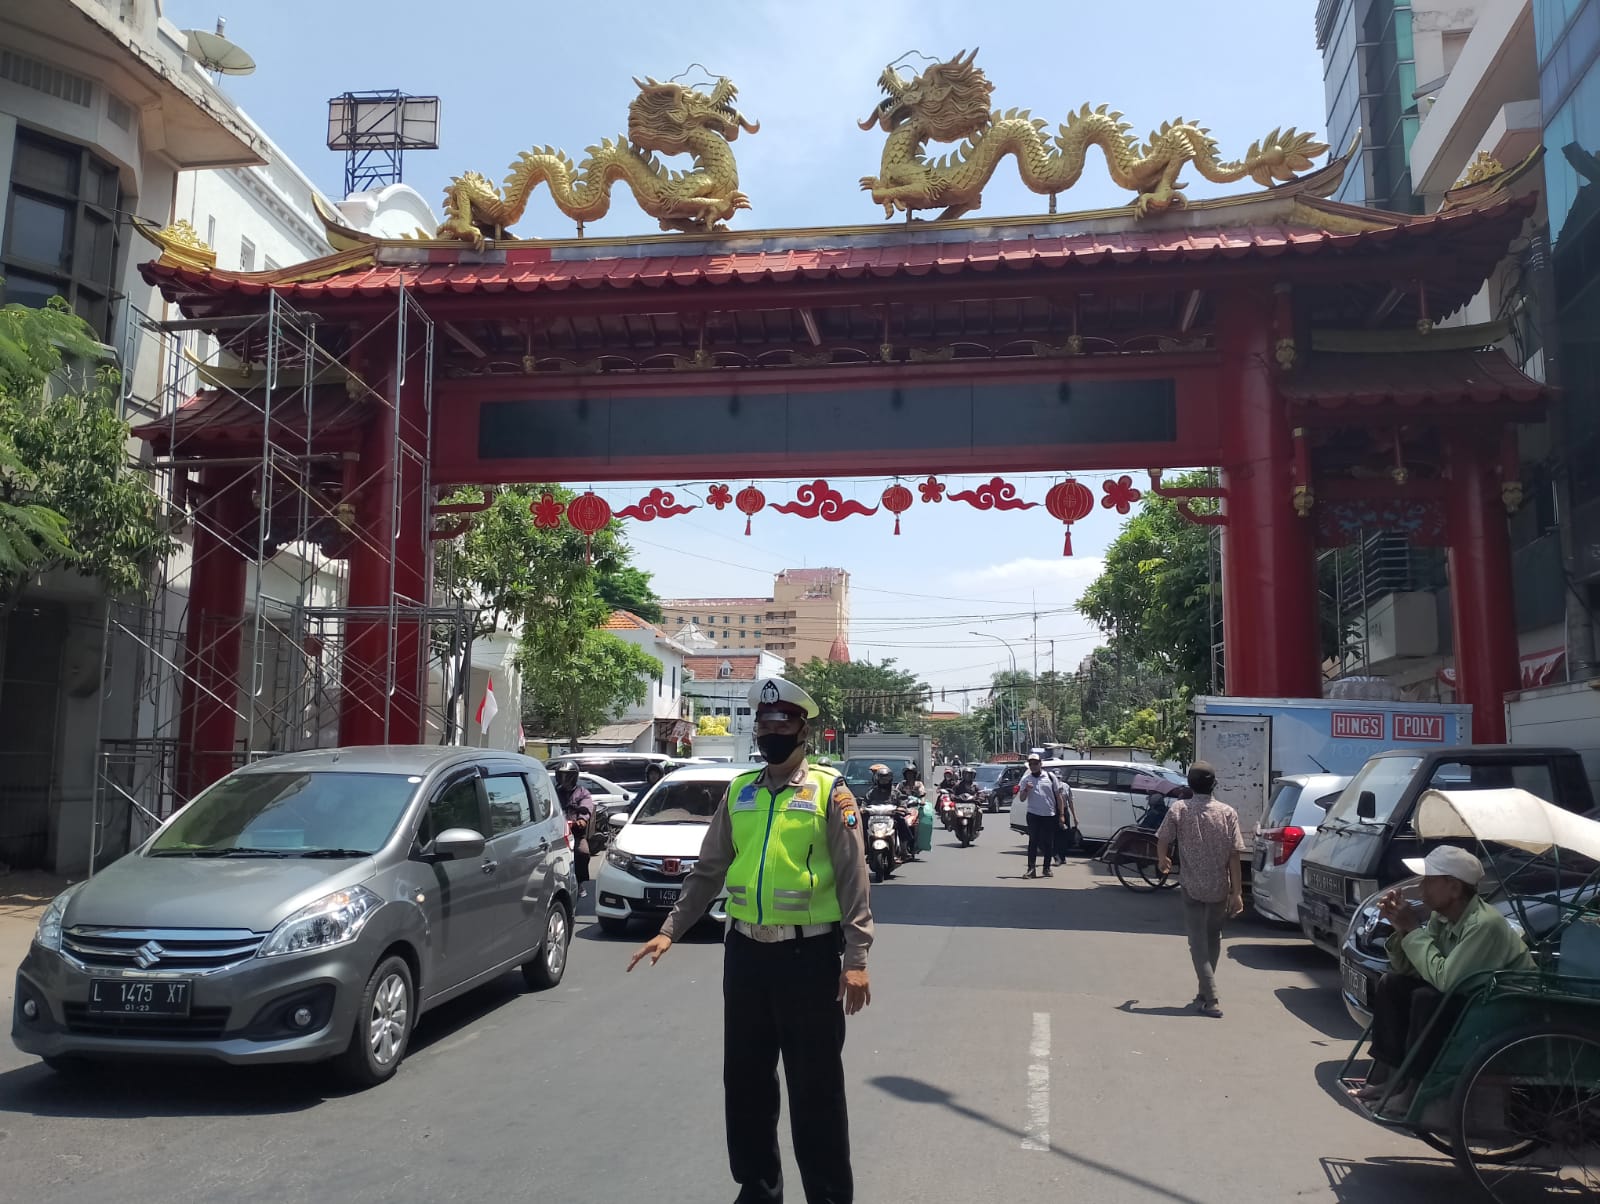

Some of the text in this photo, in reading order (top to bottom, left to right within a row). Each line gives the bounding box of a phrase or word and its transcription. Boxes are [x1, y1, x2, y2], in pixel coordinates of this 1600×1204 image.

[1337, 715, 1434, 736] HING'S POLY
[93, 984, 186, 1003] L 1475 XT
